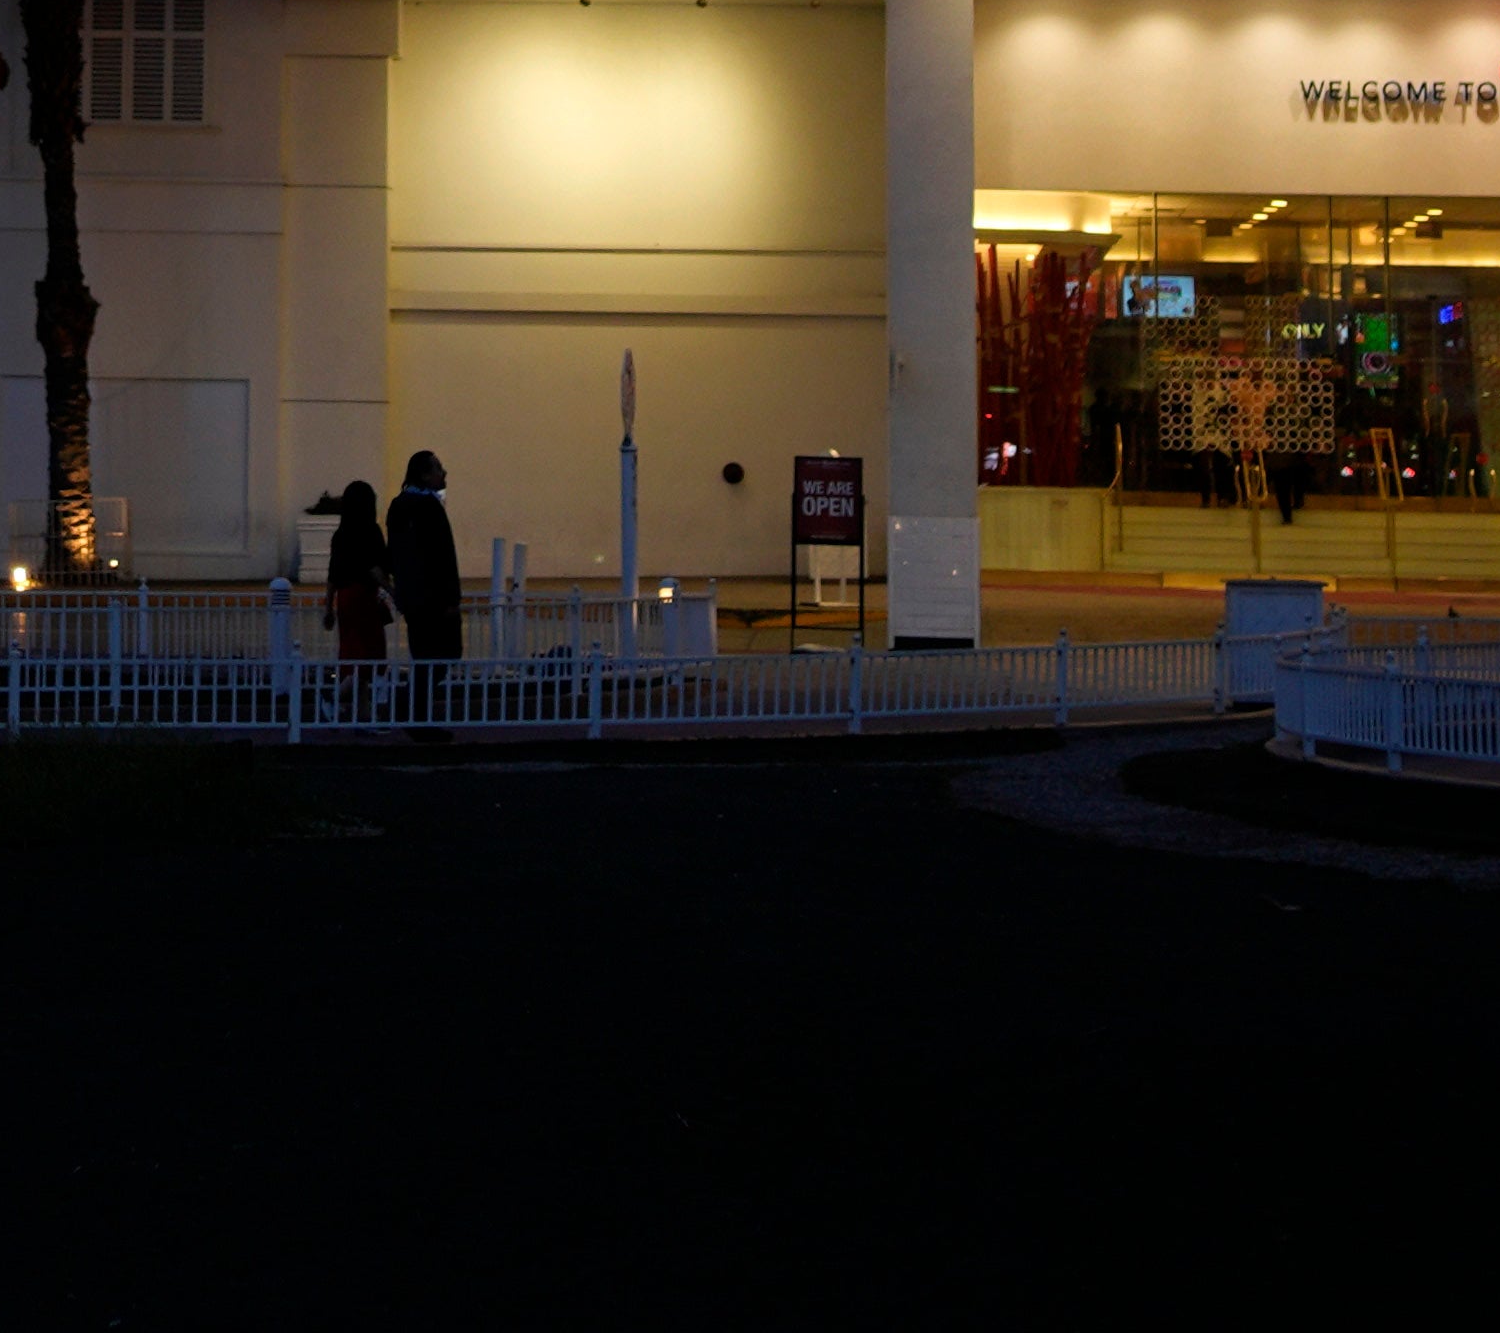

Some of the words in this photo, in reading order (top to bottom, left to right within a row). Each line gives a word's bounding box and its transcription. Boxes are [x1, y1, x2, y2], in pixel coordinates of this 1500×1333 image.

[1300, 79, 1448, 103] WELCOME
[1459, 82, 1497, 103] TO
[803, 480, 825, 495] WE
[827, 480, 855, 496] ARE
[802, 496, 855, 518] OPEN
